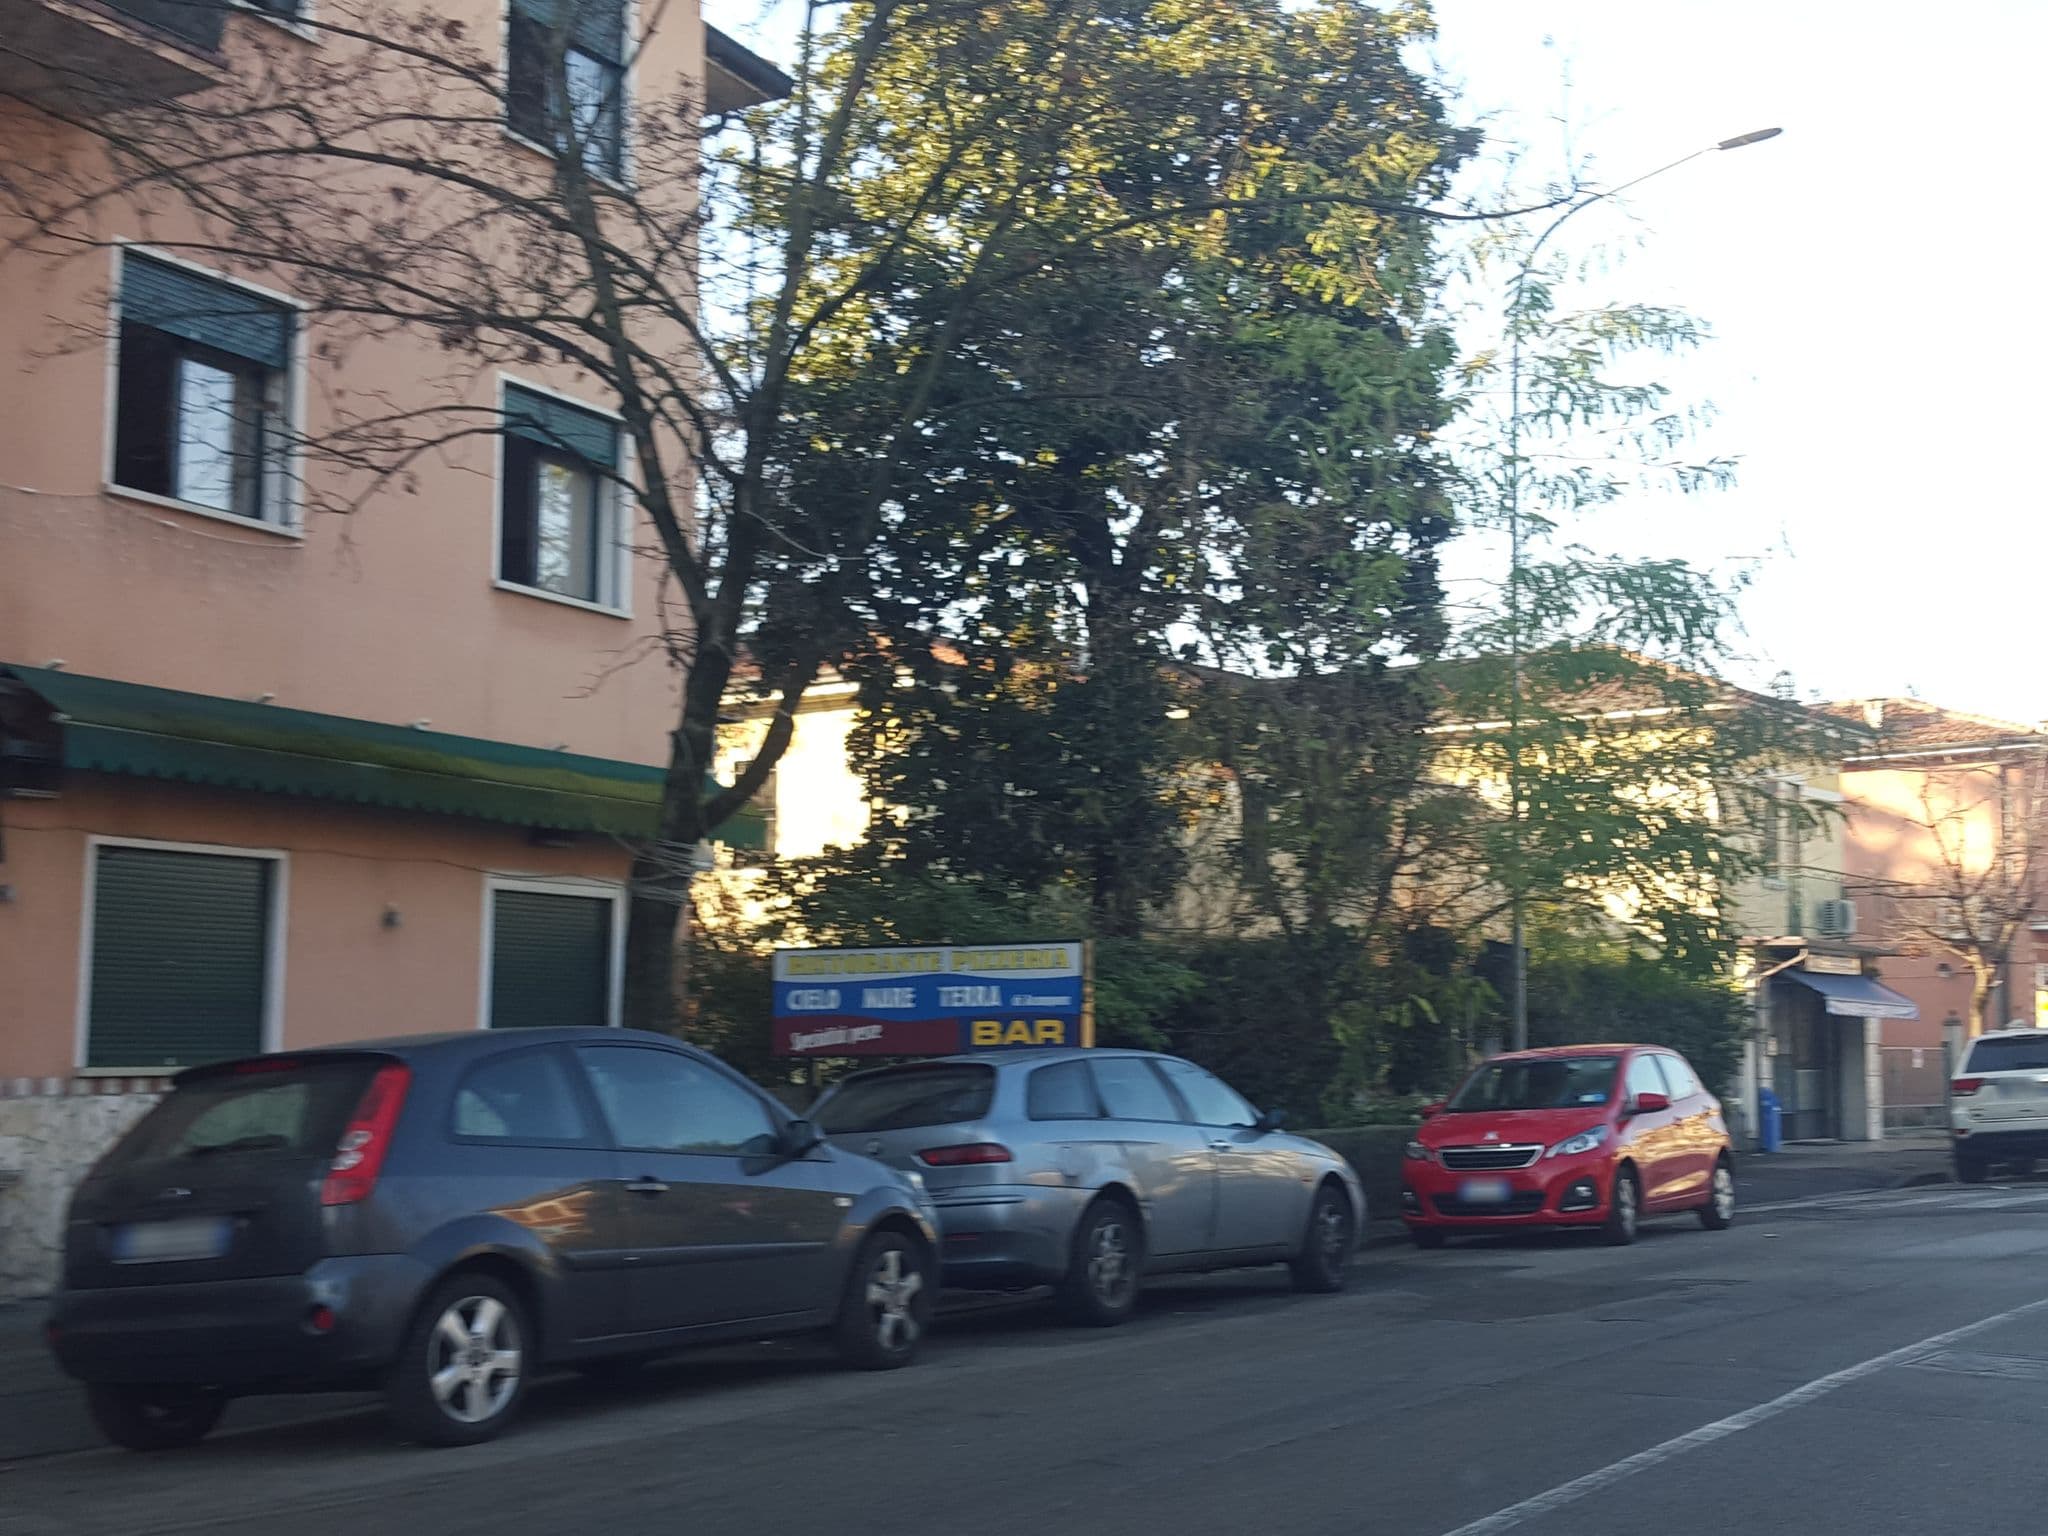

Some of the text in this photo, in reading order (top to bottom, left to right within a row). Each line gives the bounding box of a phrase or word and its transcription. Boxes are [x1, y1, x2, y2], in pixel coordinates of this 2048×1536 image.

[951, 948, 1070, 971] PIZZERIA
[786, 989, 842, 1010] CIELO
[861, 987, 917, 1008] MARE
[936, 985, 1002, 1007] TERRA
[970, 1019, 1066, 1046] BAR
